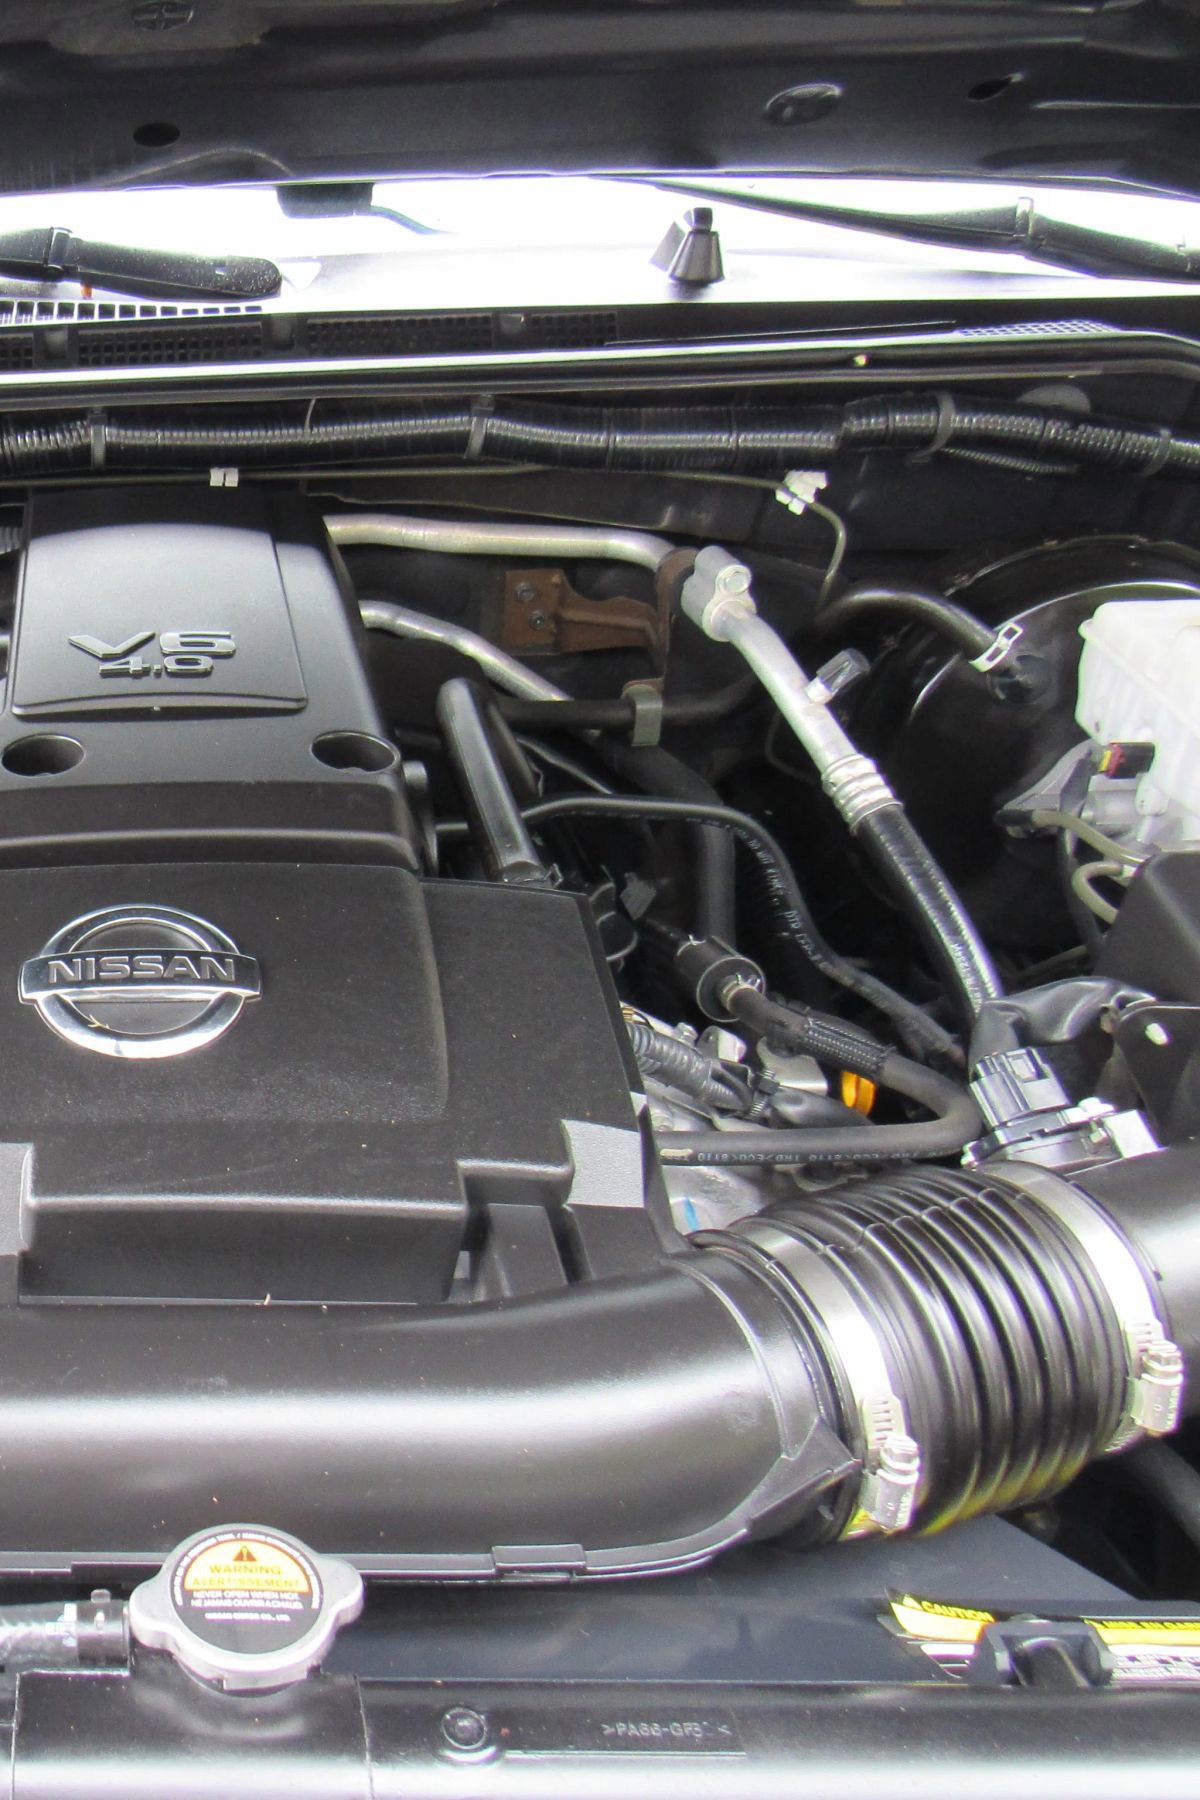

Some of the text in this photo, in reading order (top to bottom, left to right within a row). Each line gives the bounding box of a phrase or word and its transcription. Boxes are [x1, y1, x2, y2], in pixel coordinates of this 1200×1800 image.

[68, 631, 236, 658] V6
[99, 655, 214, 676] 4.0
[48, 956, 236, 983] NISSAN
[209, 1565, 282, 1575] WARNING
[921, 1600, 995, 1623] CAUTION
